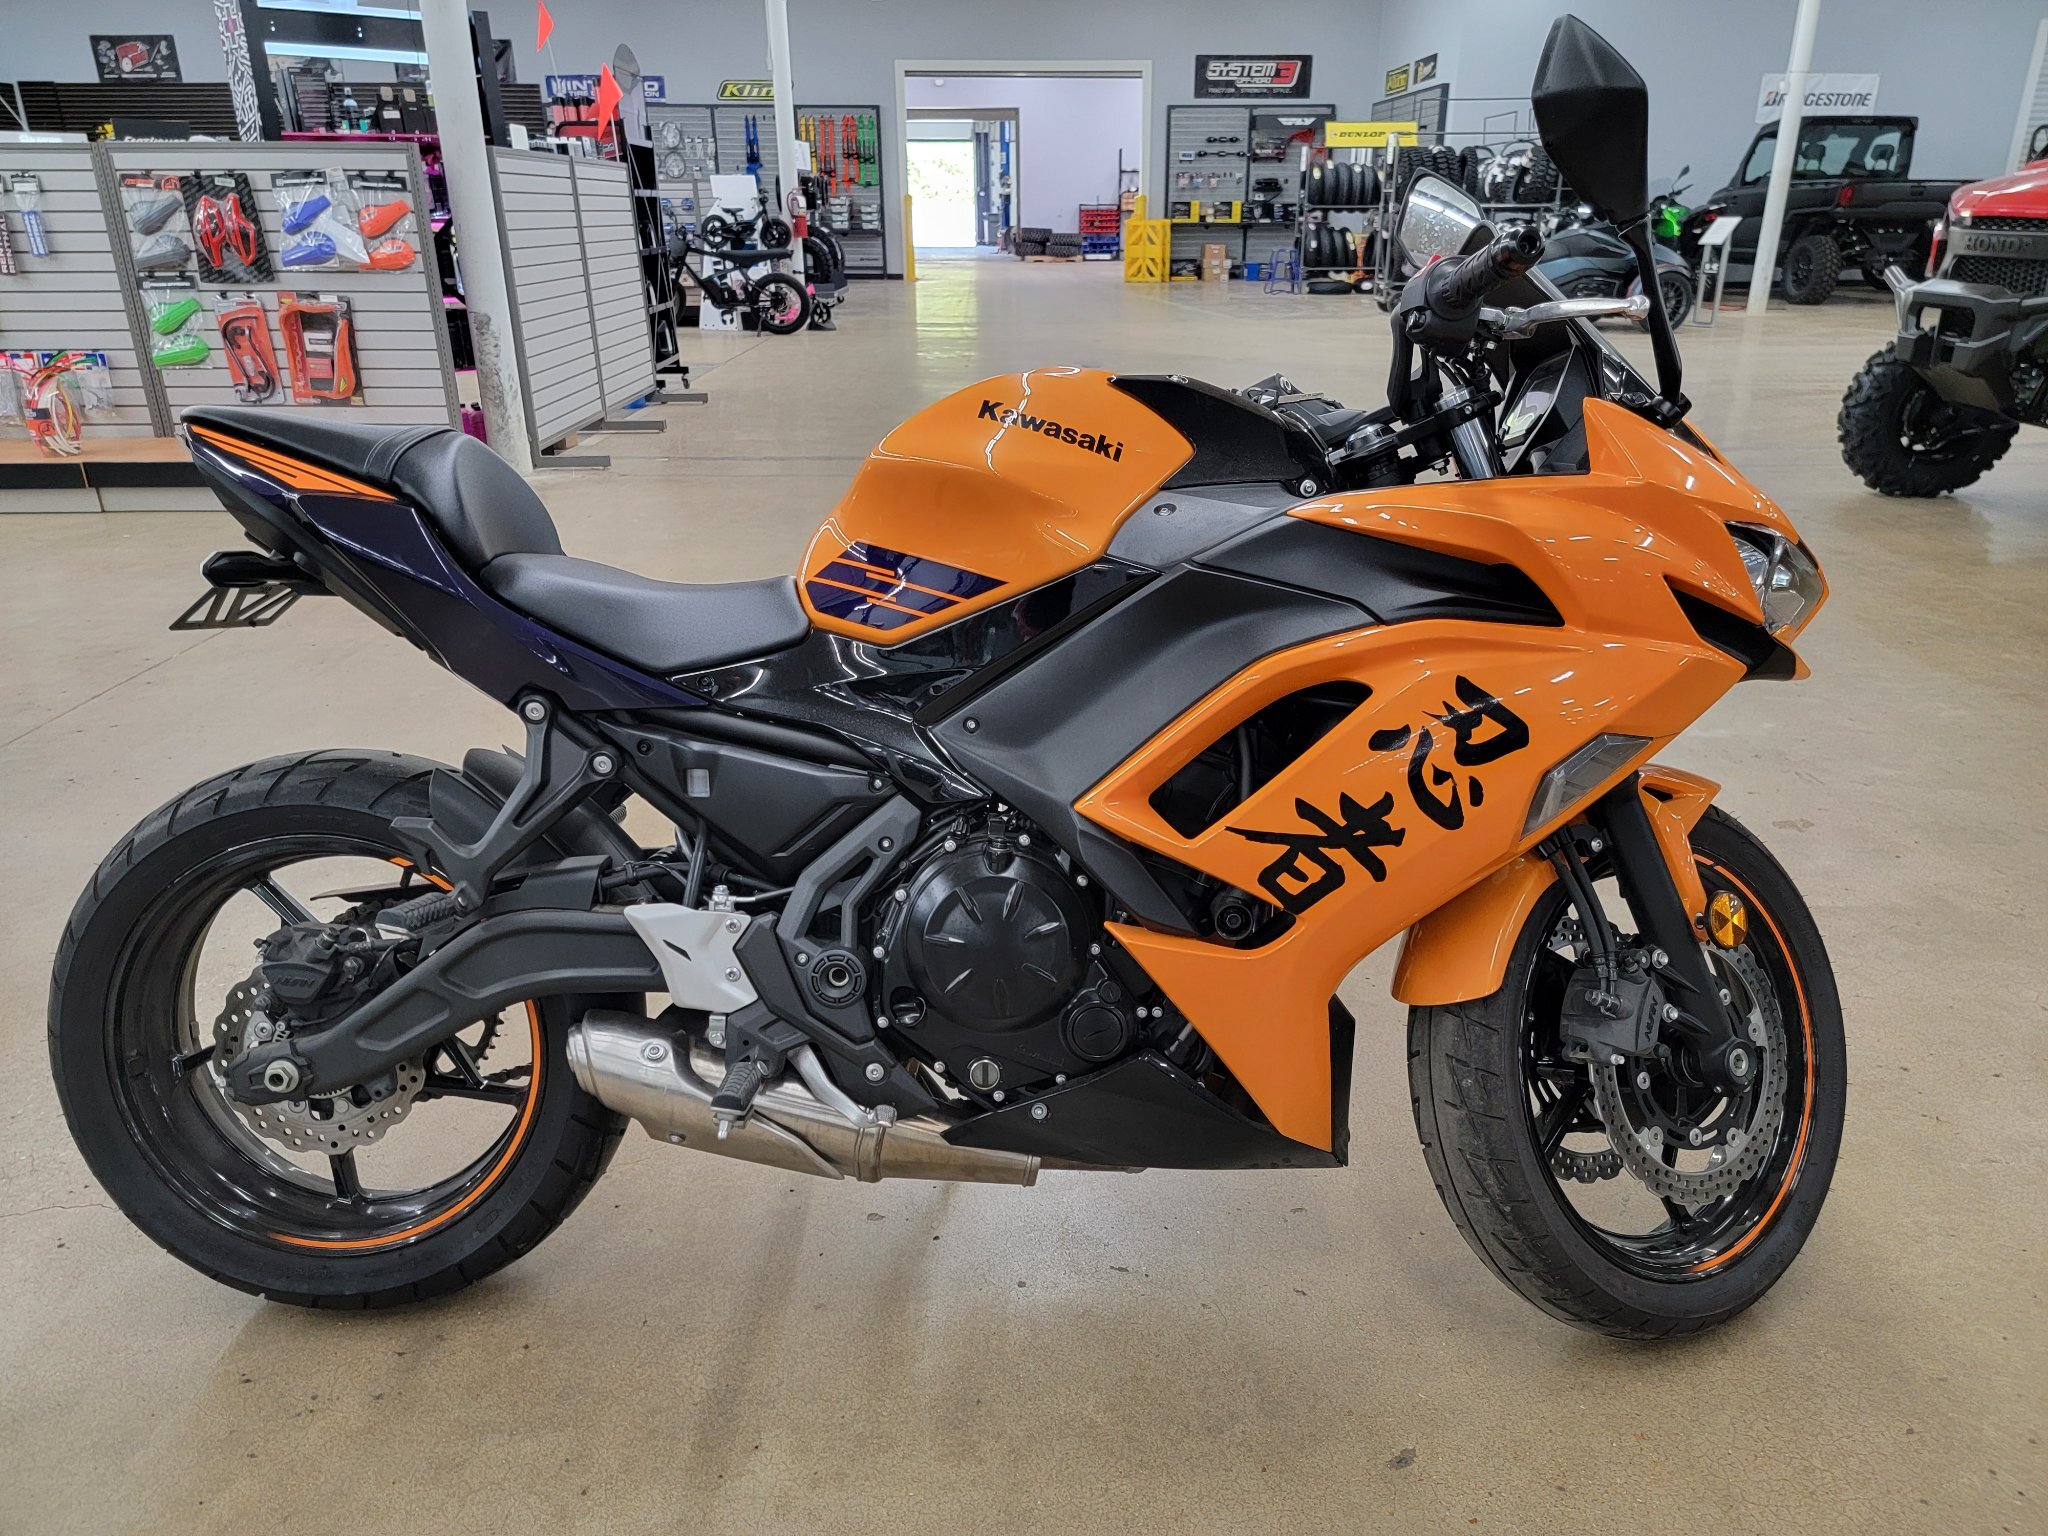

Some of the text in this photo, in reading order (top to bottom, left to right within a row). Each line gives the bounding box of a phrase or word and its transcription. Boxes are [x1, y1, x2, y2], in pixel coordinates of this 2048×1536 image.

[1207, 62, 1298, 84] SYSTEM 3
[978, 399, 1124, 463] Kawasaki
[1224, 674, 1530, 916] 忍者
